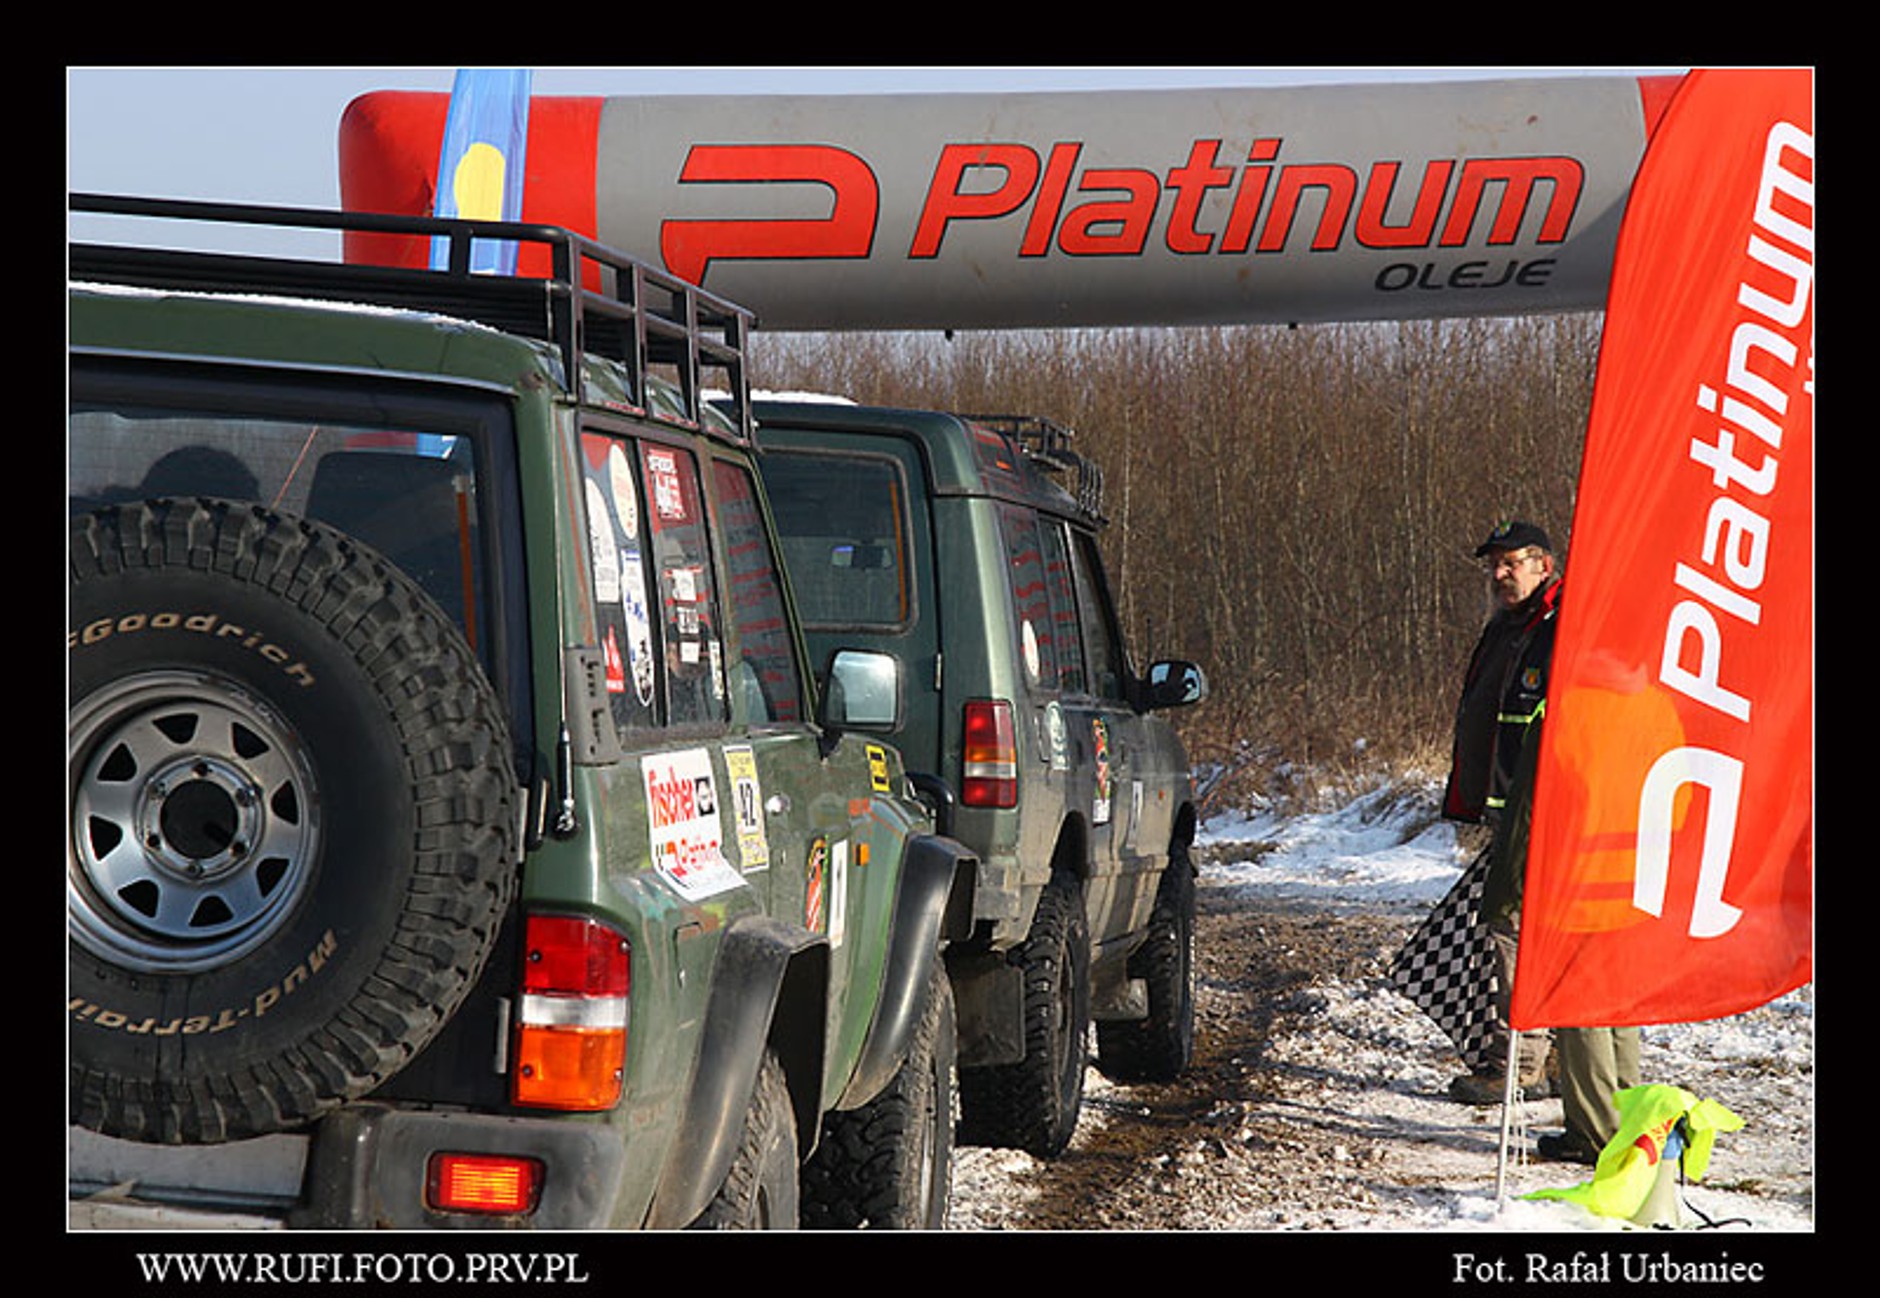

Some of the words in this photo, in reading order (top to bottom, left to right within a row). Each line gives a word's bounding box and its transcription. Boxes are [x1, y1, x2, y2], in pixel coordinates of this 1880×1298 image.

[907, 137, 1585, 259] Platinum
[1374, 258, 1557, 293] OLEJE
[1658, 120, 1814, 723] Platinum
